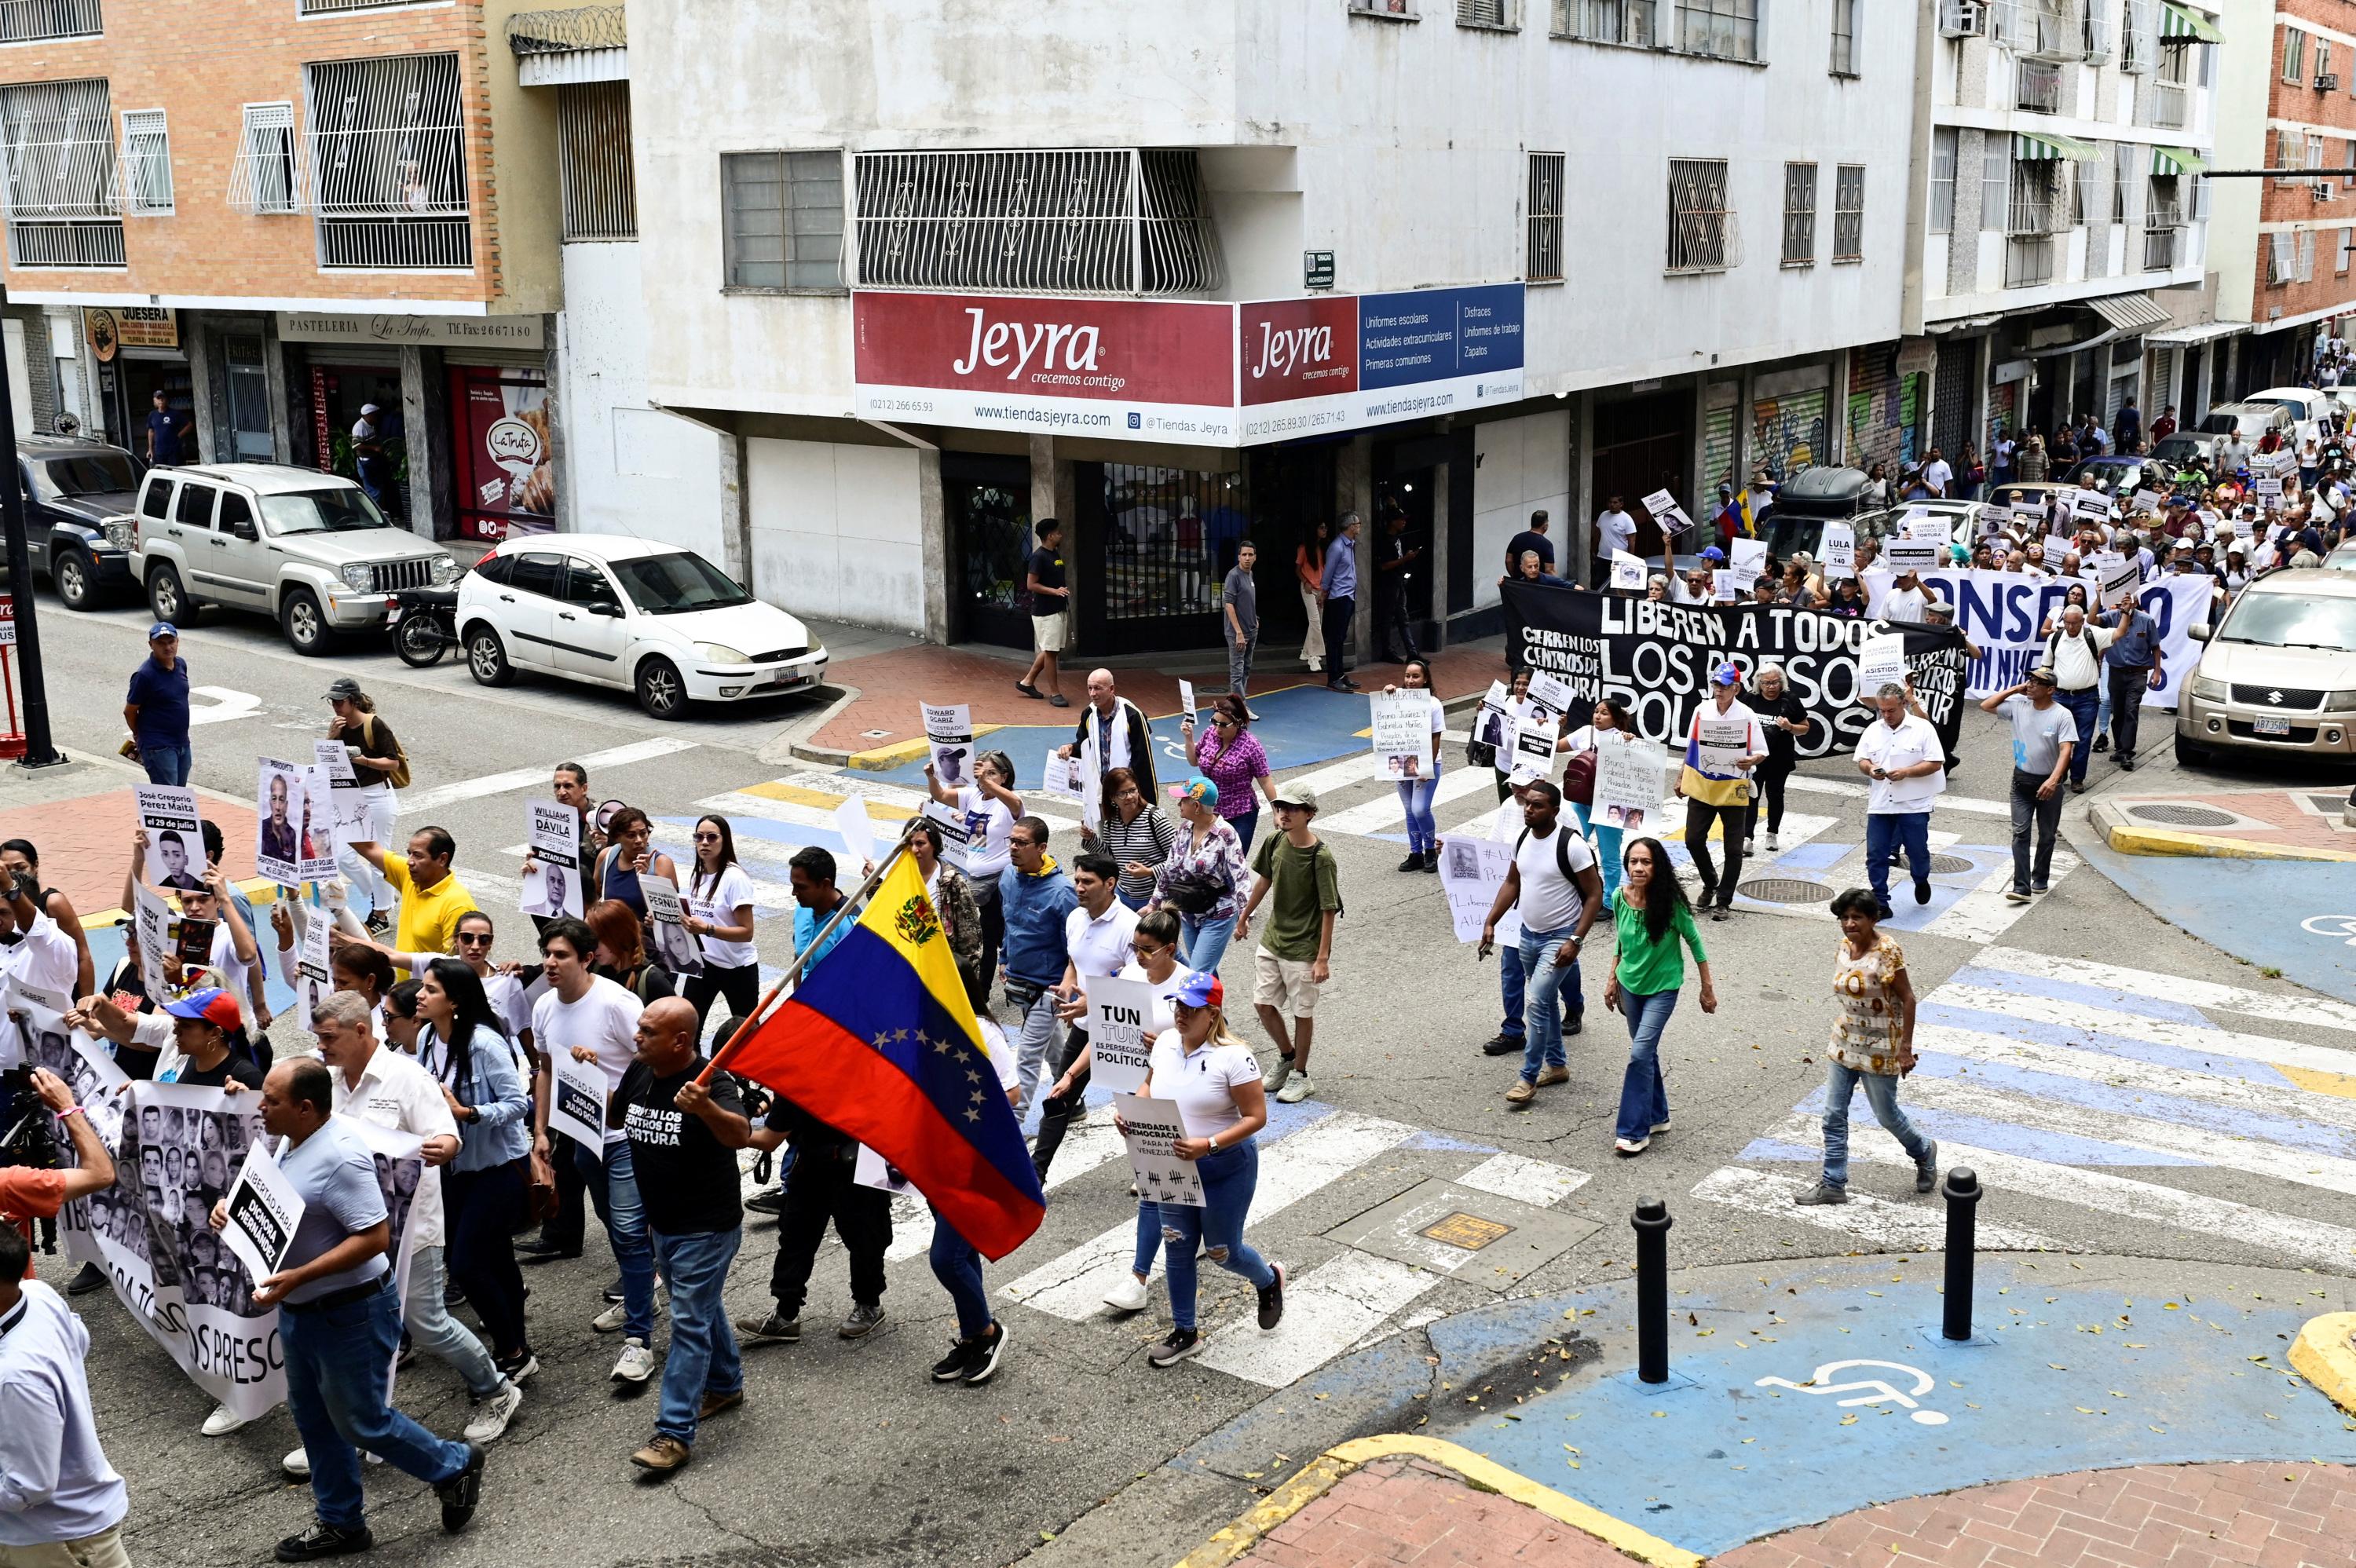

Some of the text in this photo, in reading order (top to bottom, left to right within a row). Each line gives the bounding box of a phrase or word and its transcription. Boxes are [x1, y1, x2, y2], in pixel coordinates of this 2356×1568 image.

[122, 307, 169, 321] QUESERA
[1464, 306, 1491, 318] Disfraces
[1365, 313, 1429, 328] Uniformes escolares
[290, 320, 358, 332] PASTELERIA
[447, 323, 462, 334] Tlf.
[463, 323, 479, 335] Fax:
[481, 326, 531, 337] 2667180
[1464, 322, 1520, 338] Uniformes de trabajo
[953, 307, 1099, 380] Jeyra
[1365, 331, 1452, 349] Actividades extracurriculares
[1253, 321, 1331, 378] Jeyra
[1464, 345, 1487, 359] Zapatos
[1365, 353, 1432, 371] Primeras comuniones
[1302, 365, 1349, 380] crecemos contigo
[1031, 371, 1125, 392] crecemos contigo
[1484, 383, 1519, 396] @TiendasJeyra
[869, 397, 933, 412] (0212) 266 65.93
[1366, 393, 1454, 417] www.tiendasjeyra.com
[975, 405, 1110, 427] www.tiendasjeyra.com
[1146, 417, 1227, 435] @Tiendas Jeyra
[1246, 421, 1270, 437] (0212)
[1828, 539, 1850, 548] LULA
[2106, 580, 2117, 590] LULA
[1601, 596, 1890, 655] LIBEREN A TODOS
[1522, 626, 1601, 654] CIERREN LOS
[1523, 645, 1601, 676] CENTROS DE
[1601, 638, 1695, 695] LOS
[1544, 681, 1561, 692] BRUNO
[1380, 690, 1421, 701] LIBERTAD
[1396, 701, 1400, 710] A
[1531, 696, 1558, 713] DICTADURA
[1377, 711, 1396, 721] Bruno
[1520, 726, 1540, 736] LIBERTAD
[2255, 718, 2288, 731] AB735DG
[1521, 736, 1552, 749] MANUEL DAVID
[1528, 744, 1544, 753] TORRES
[1622, 749, 1631, 759] A
[269, 759, 294, 772] PERIODISTA
[1604, 755, 1659, 776] Bruno Y
[1637, 784, 1644, 792] de
[139, 791, 192, 802] José Gregorio
[140, 799, 195, 813] Perez Maita
[534, 806, 571, 822] WILLIAMS
[177, 821, 195, 829] julio
[536, 818, 571, 836] DÁVILA
[536, 832, 573, 848] SECUESTRADO
[538, 850, 570, 865] DICTADURA
[648, 895, 679, 909] PERNIA
[655, 912, 681, 923] MADURO
[1101, 1004, 1140, 1025] TUN
[1101, 1023, 1143, 1045] TUN
[1105, 1044, 1151, 1057] PERSECUCIÓN
[1096, 1051, 1150, 1069] POLÍTICA
[557, 1067, 603, 1102] LIBERTAD PARA
[572, 1093, 595, 1114] CARLOS
[565, 1099, 601, 1130] JULIO ROJAS
[660, 1109, 682, 1123] LOS
[625, 1113, 682, 1133] CENTROS DE
[1125, 1120, 1170, 1131] LIBERDADE
[1126, 1128, 1182, 1139] DEMOCRACIA
[246, 1166, 293, 1234] LIBERTAD PARA
[247, 1198, 278, 1244] DIGNORA
[237, 1206, 276, 1263] HERNÁNDEZ
